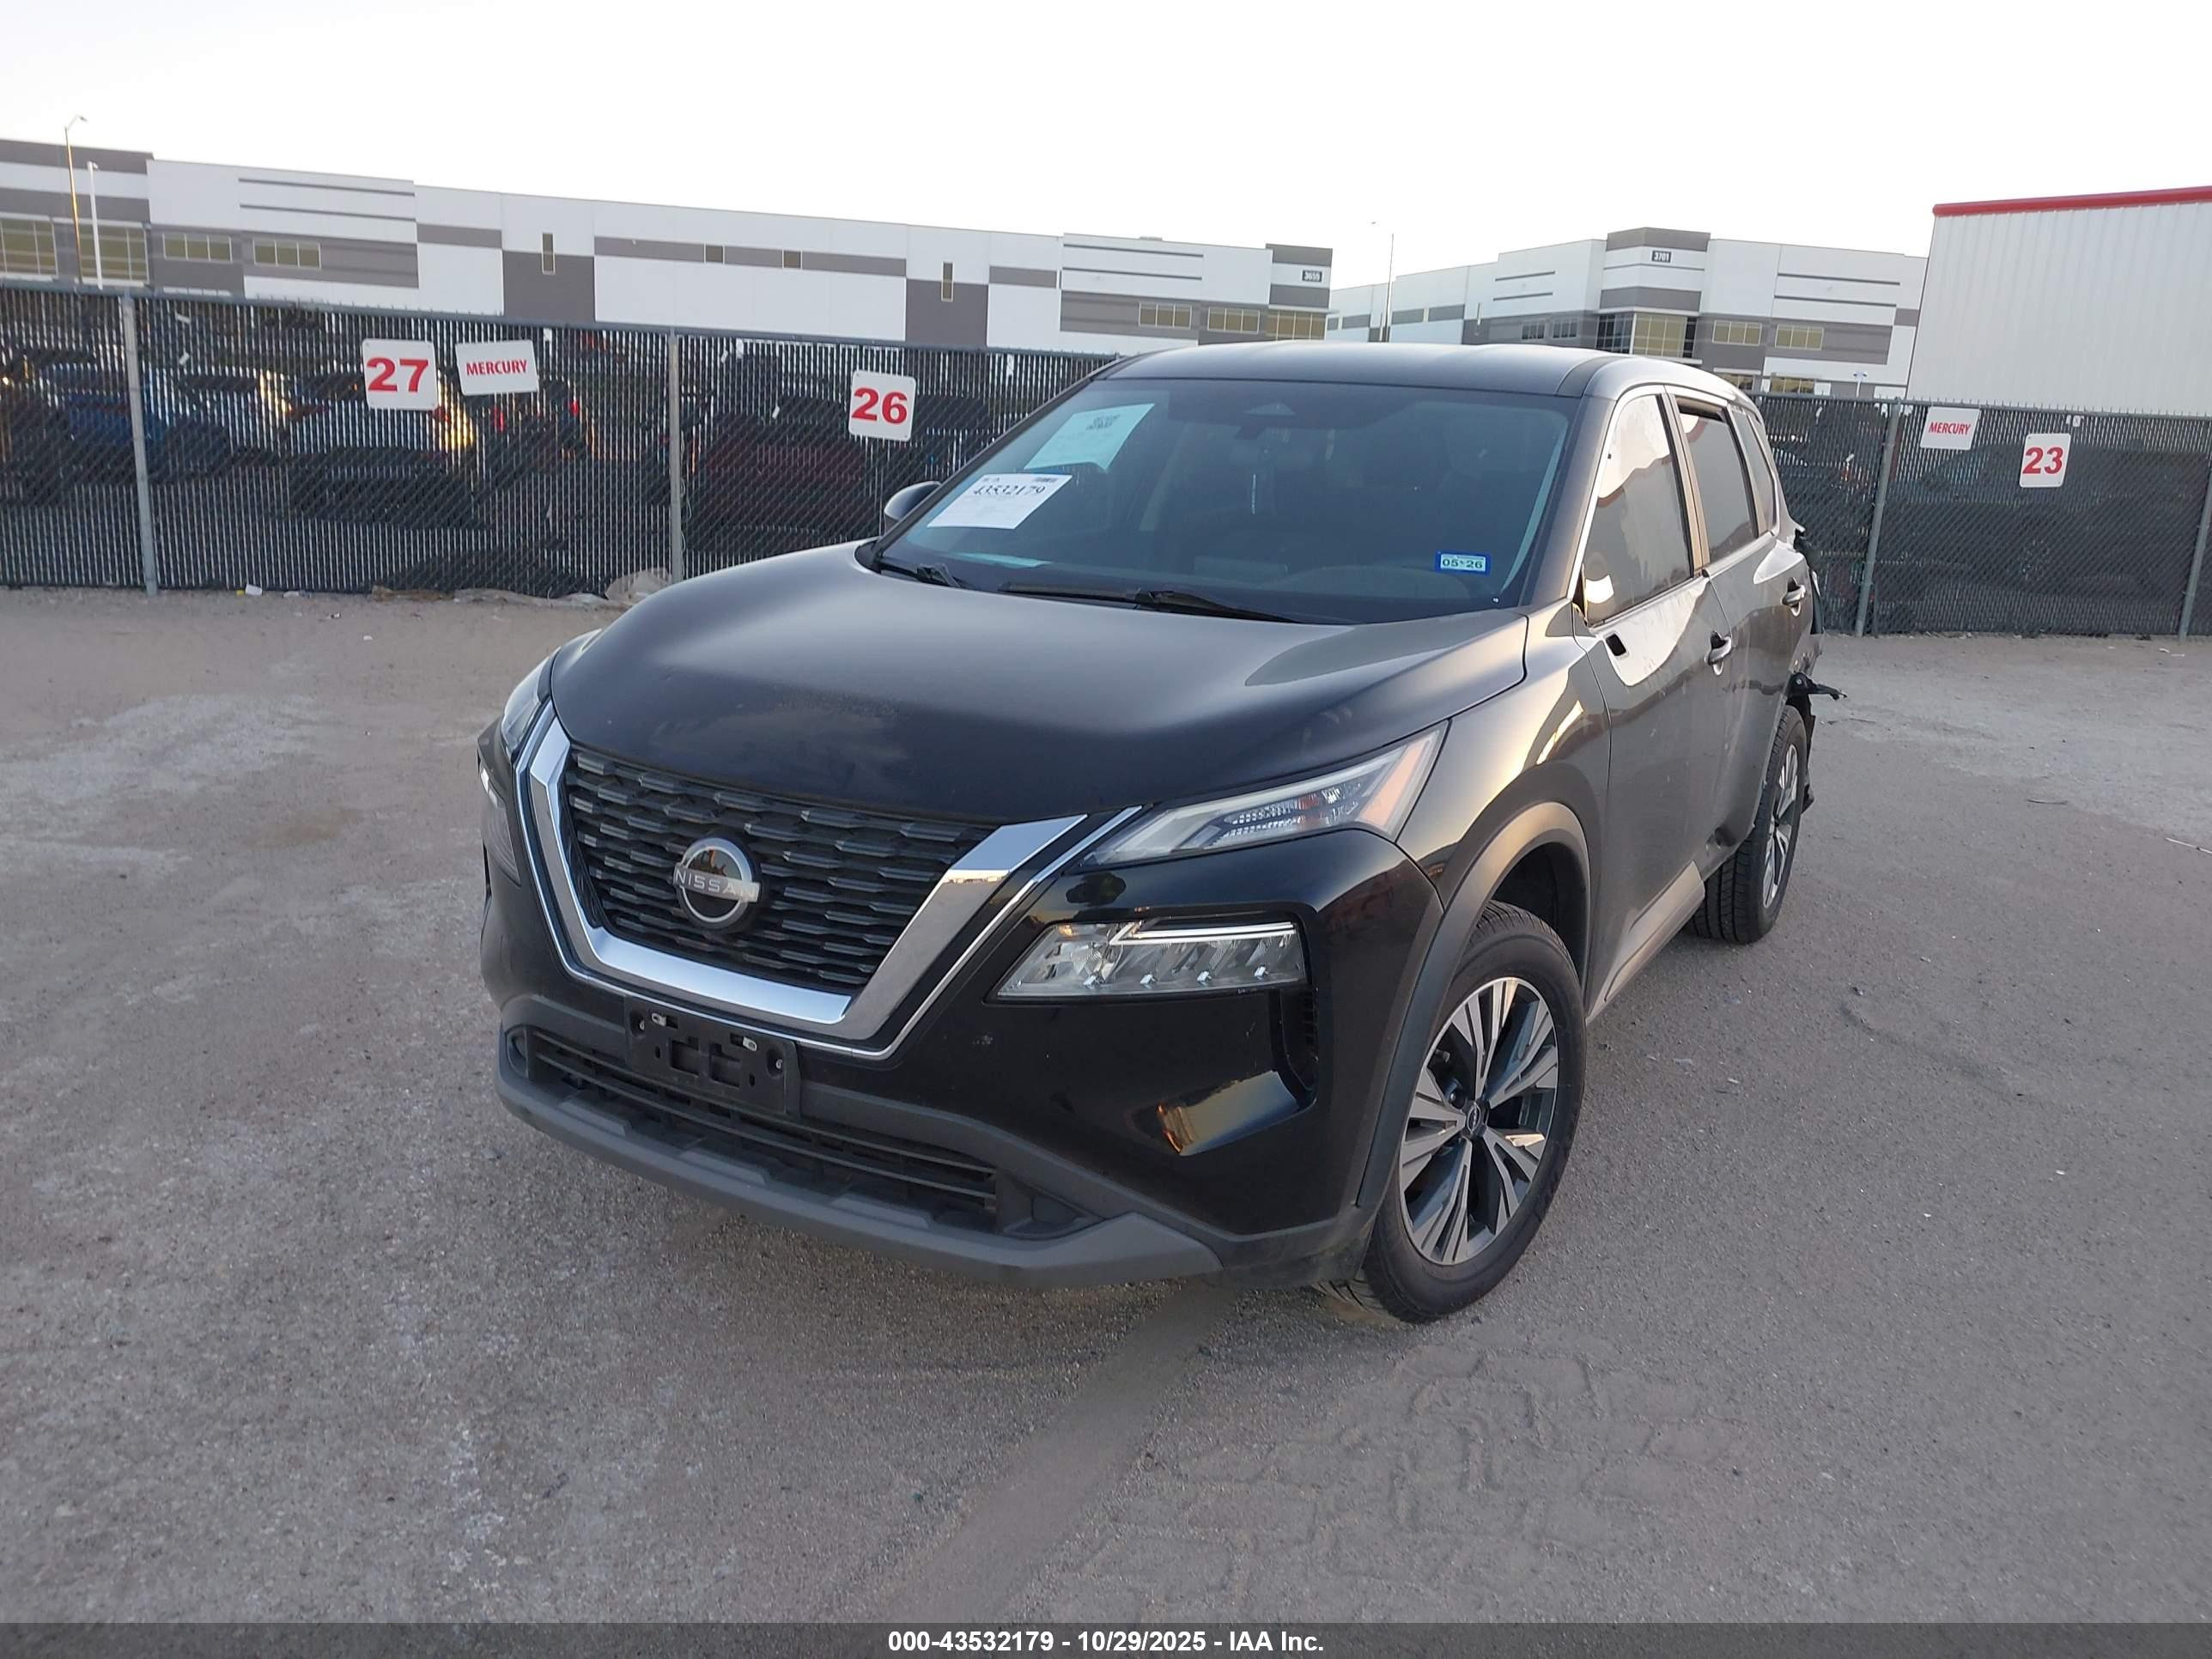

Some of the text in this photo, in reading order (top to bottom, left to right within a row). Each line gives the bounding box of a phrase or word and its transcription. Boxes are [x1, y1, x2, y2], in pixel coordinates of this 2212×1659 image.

[1654, 252, 1669, 262] 3701
[366, 357, 429, 393] 27
[466, 359, 527, 376] MERCURY
[851, 387, 908, 424] 26
[1929, 421, 1972, 435] MERCURY
[2022, 447, 2063, 474] 23
[1442, 558, 1483, 569] 05 26
[675, 869, 757, 896] NISSAN
